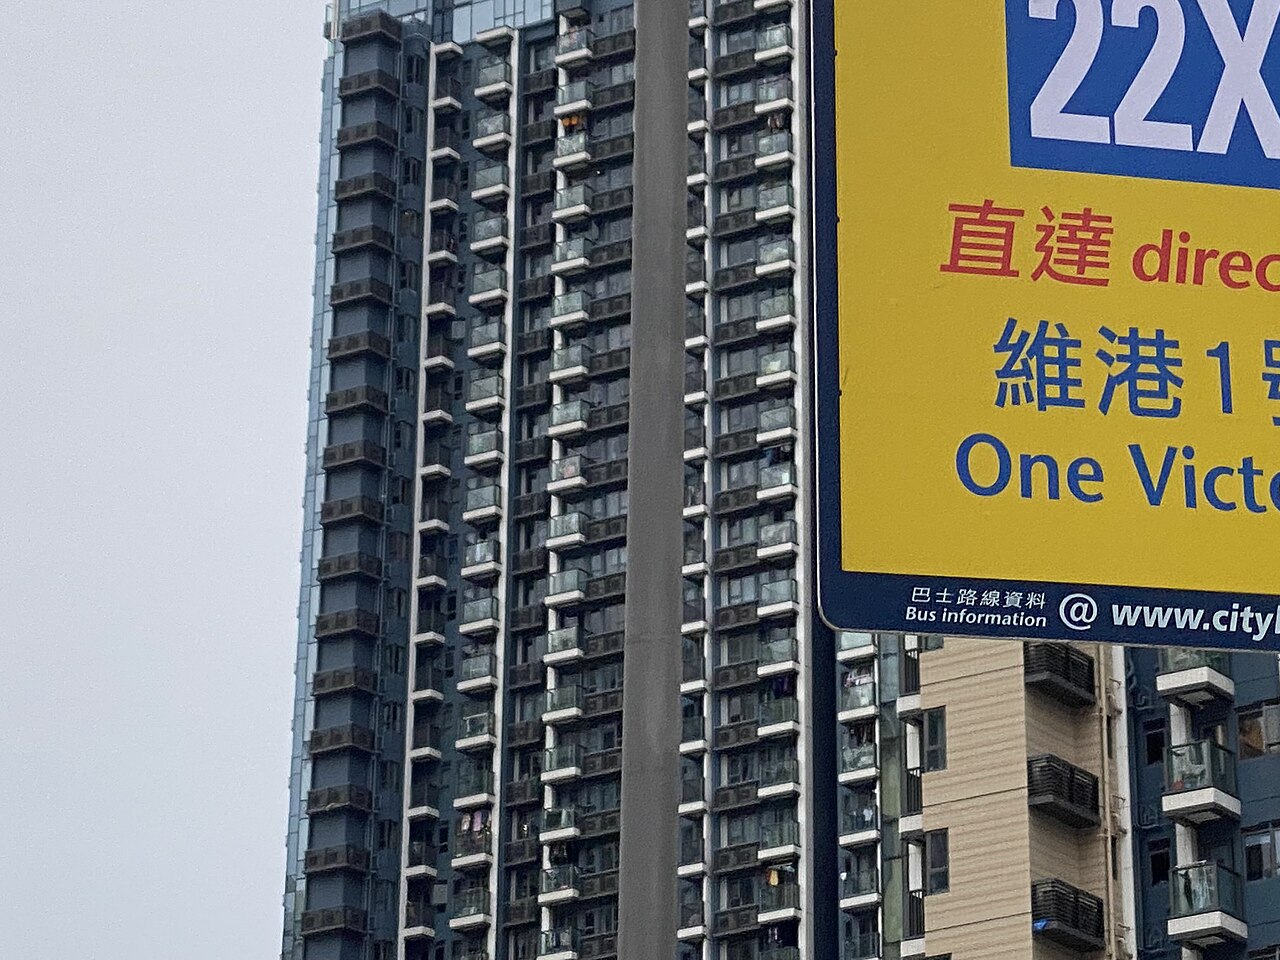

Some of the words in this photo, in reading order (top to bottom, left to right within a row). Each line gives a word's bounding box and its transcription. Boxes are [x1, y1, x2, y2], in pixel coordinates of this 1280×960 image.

[939, 198, 1114, 288] 直達
[955, 432, 1105, 504] One
[905, 606, 937, 622] Bus
[941, 607, 1047, 627] information
[911, 586, 1046, 610] 巴士路線資料
[1058, 593, 1098, 631] @
